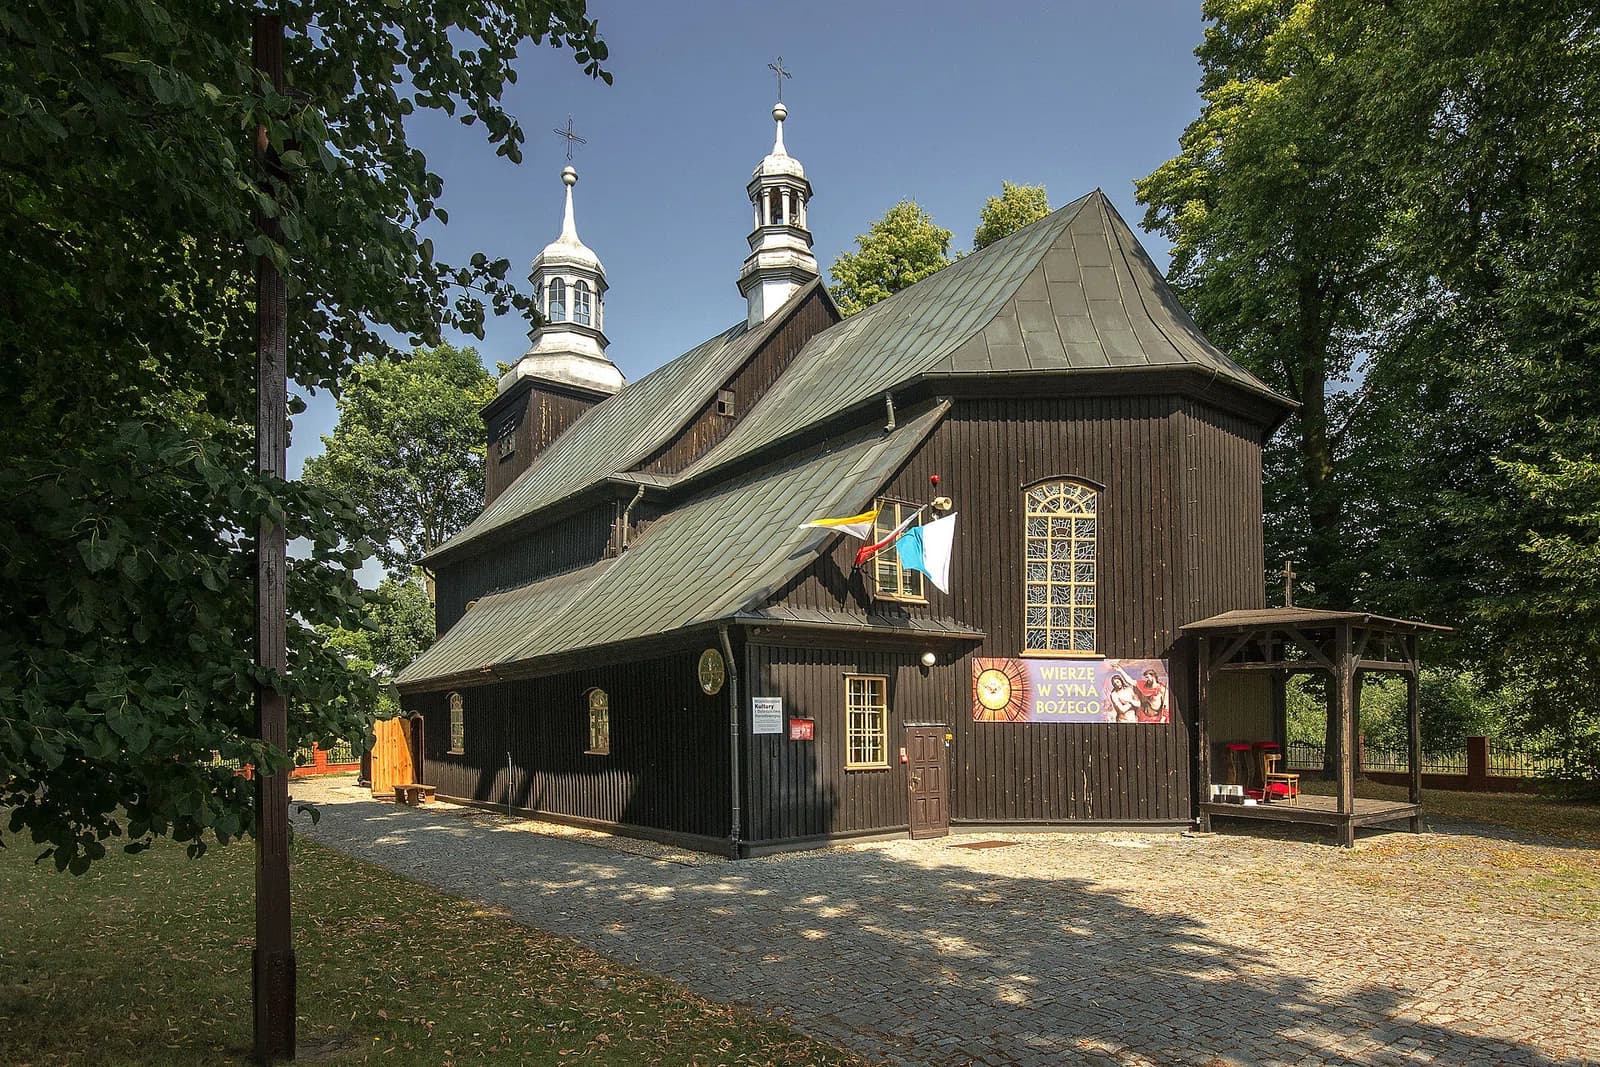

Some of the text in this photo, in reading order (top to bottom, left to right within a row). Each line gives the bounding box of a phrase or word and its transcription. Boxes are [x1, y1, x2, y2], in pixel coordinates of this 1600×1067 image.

[1040, 667, 1095, 683] WIERZĘ
[1037, 684, 1099, 697] W SYNA
[1036, 698, 1101, 714] BOŻEGO
